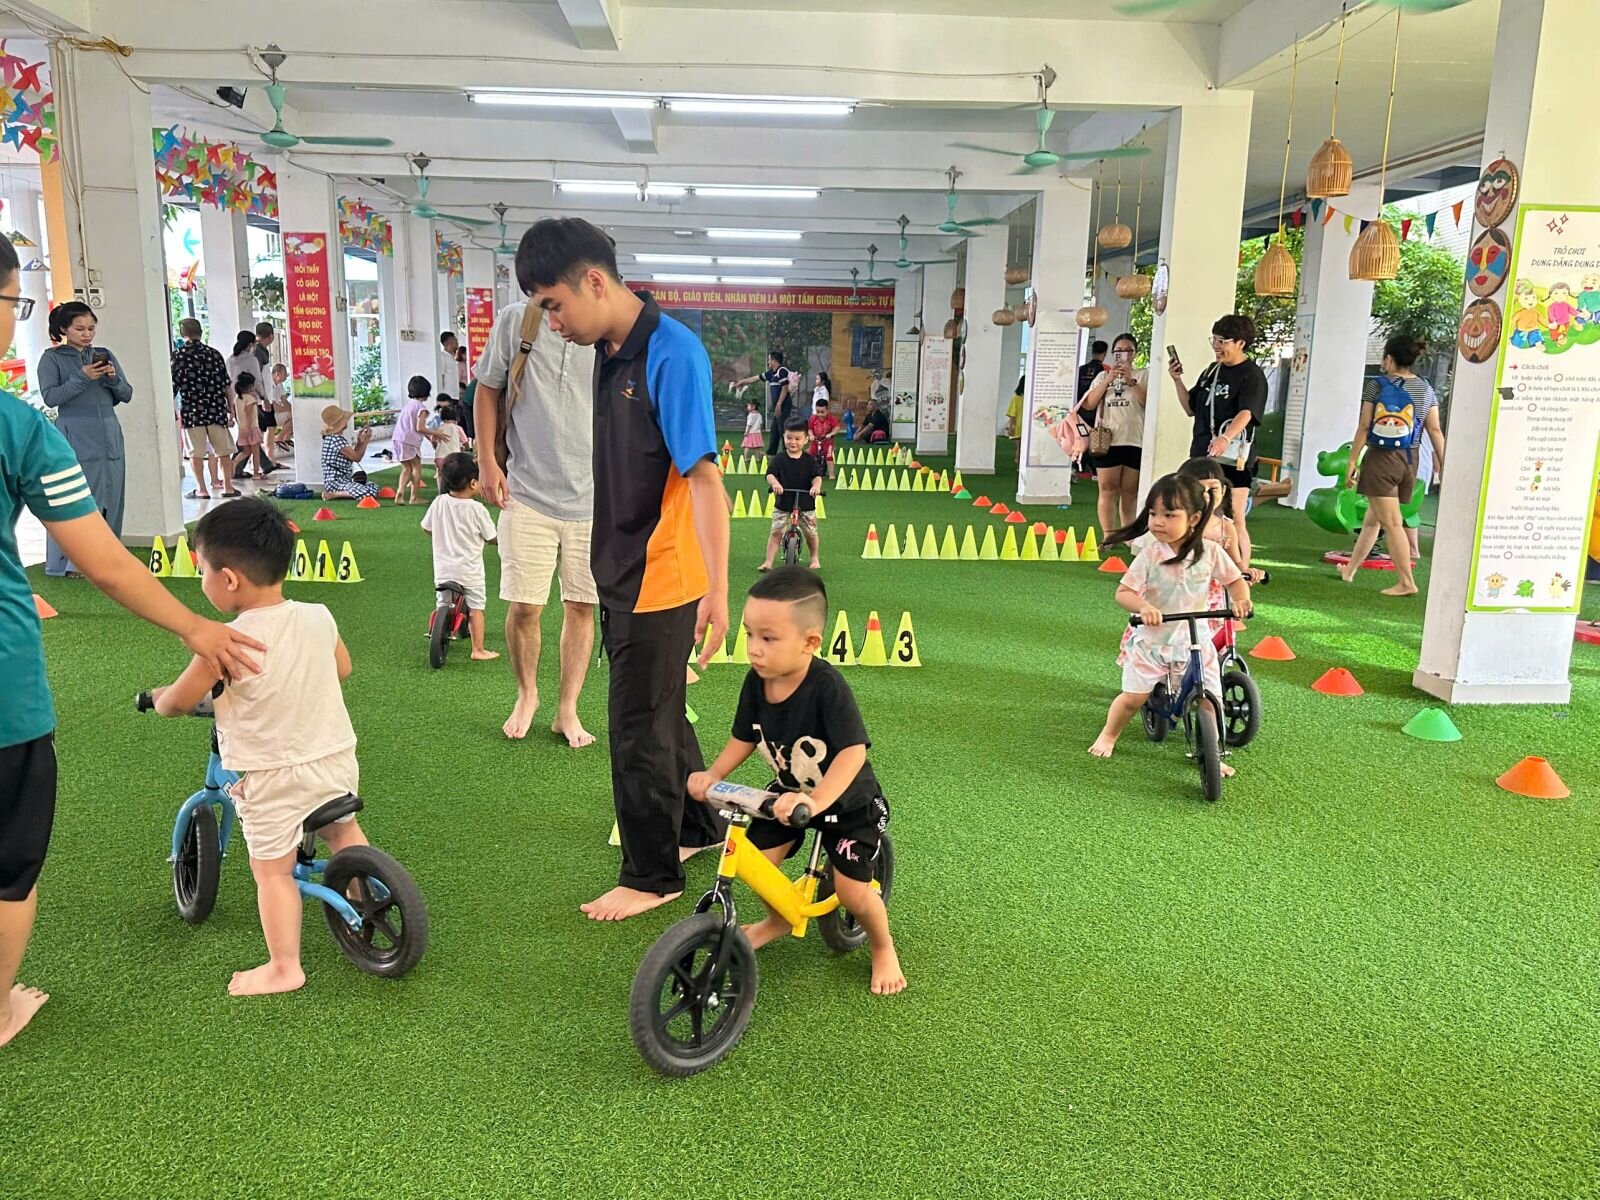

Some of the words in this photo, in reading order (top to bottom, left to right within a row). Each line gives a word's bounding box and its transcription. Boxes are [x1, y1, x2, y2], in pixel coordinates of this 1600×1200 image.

[683, 290, 701, 302] GIÁO
[150, 550, 163, 574] 8
[296, 552, 306, 577] 0
[317, 553, 326, 577] 1
[339, 556, 351, 581] 3
[832, 630, 847, 663] 4
[898, 630, 913, 662] 3
